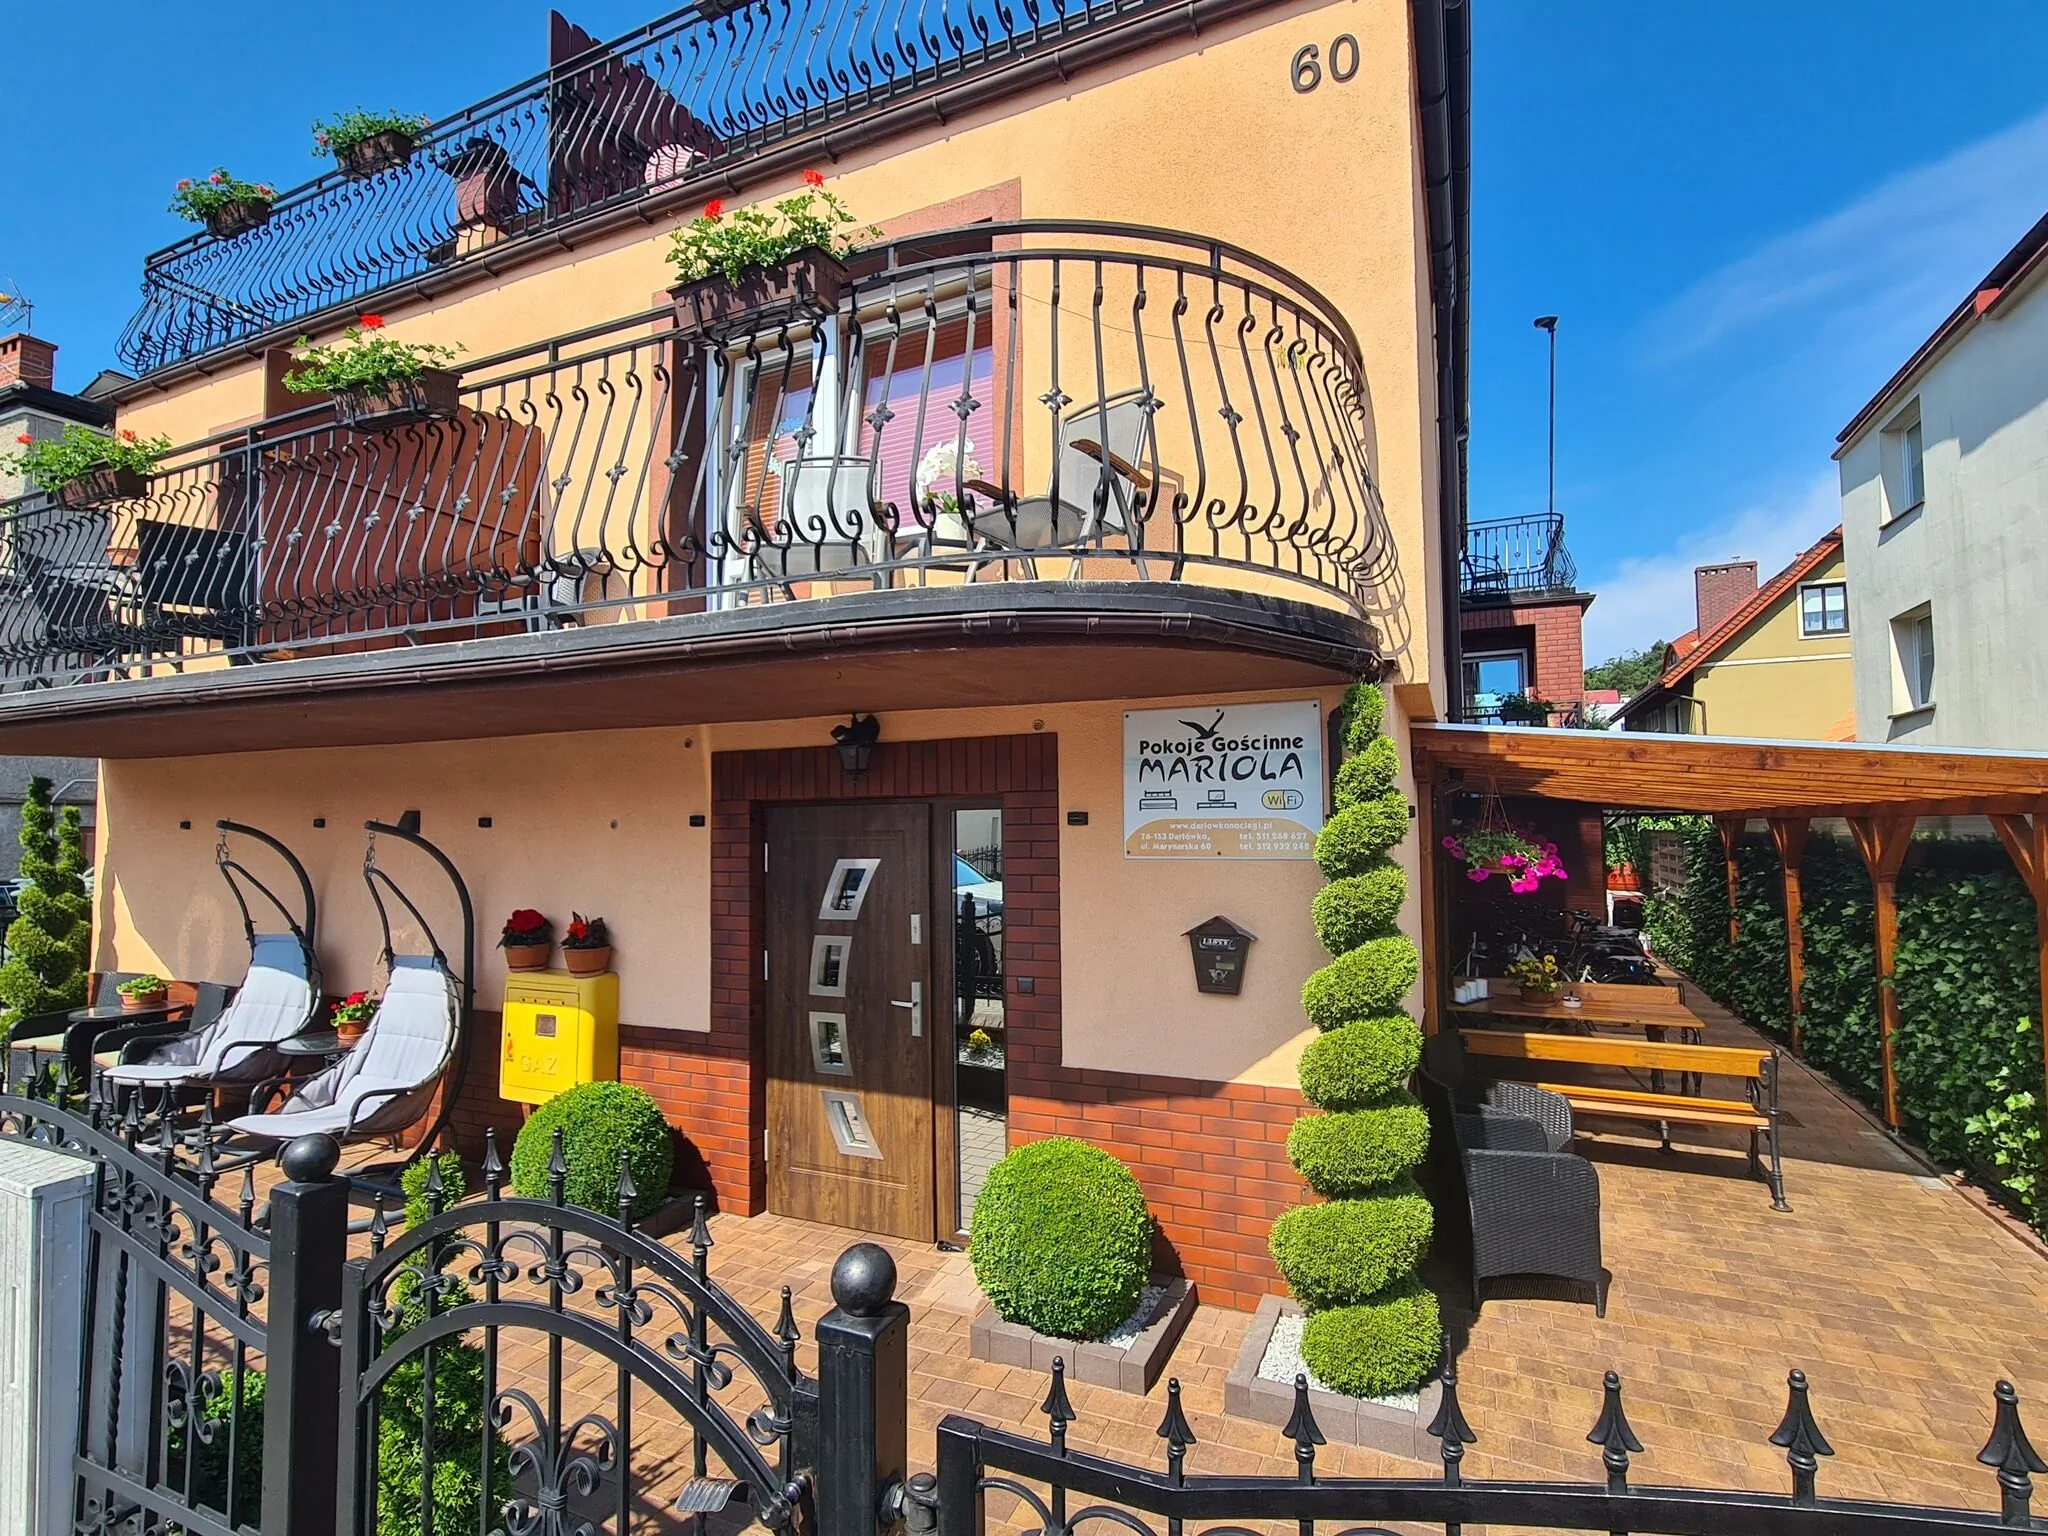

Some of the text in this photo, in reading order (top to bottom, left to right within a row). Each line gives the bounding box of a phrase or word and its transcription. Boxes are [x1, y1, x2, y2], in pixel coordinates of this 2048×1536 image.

[1291, 33, 1360, 94] 60
[1139, 734, 1304, 756] Pokoje Gościnne
[1139, 751, 1304, 783] MARIOLA
[1140, 832, 1167, 840] 76-153
[1200, 842, 1212, 850] 60
[520, 1055, 558, 1076] GAZ
